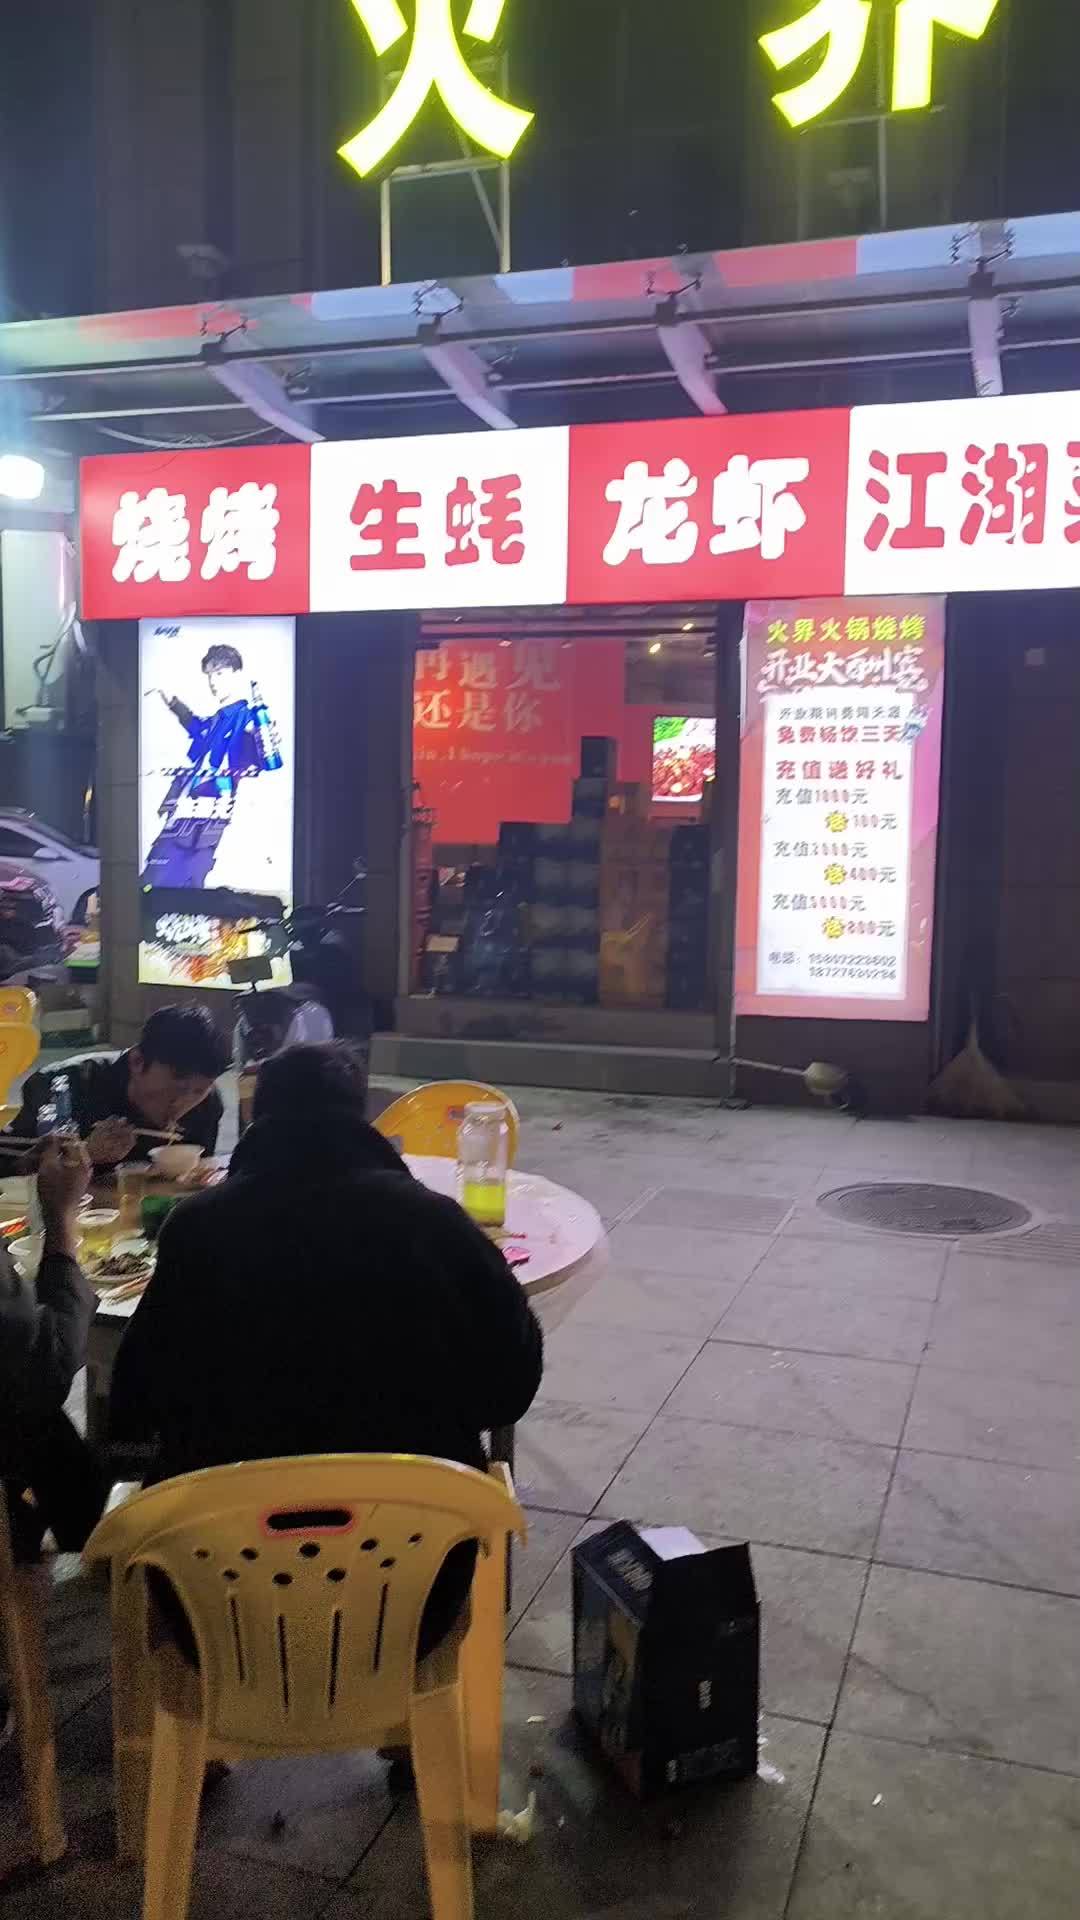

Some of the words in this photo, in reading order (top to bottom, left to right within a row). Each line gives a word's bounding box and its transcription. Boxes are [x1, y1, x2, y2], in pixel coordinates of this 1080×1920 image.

[111, 481, 281, 583] 烧烤
[349, 473, 525, 571] 生蚝
[602, 454, 810, 566] 龙虾
[863, 440, 1080, 552] 江湖
[766, 614, 927, 644] 火界火锅烧烤
[776, 759, 904, 781] 充值送好礼
